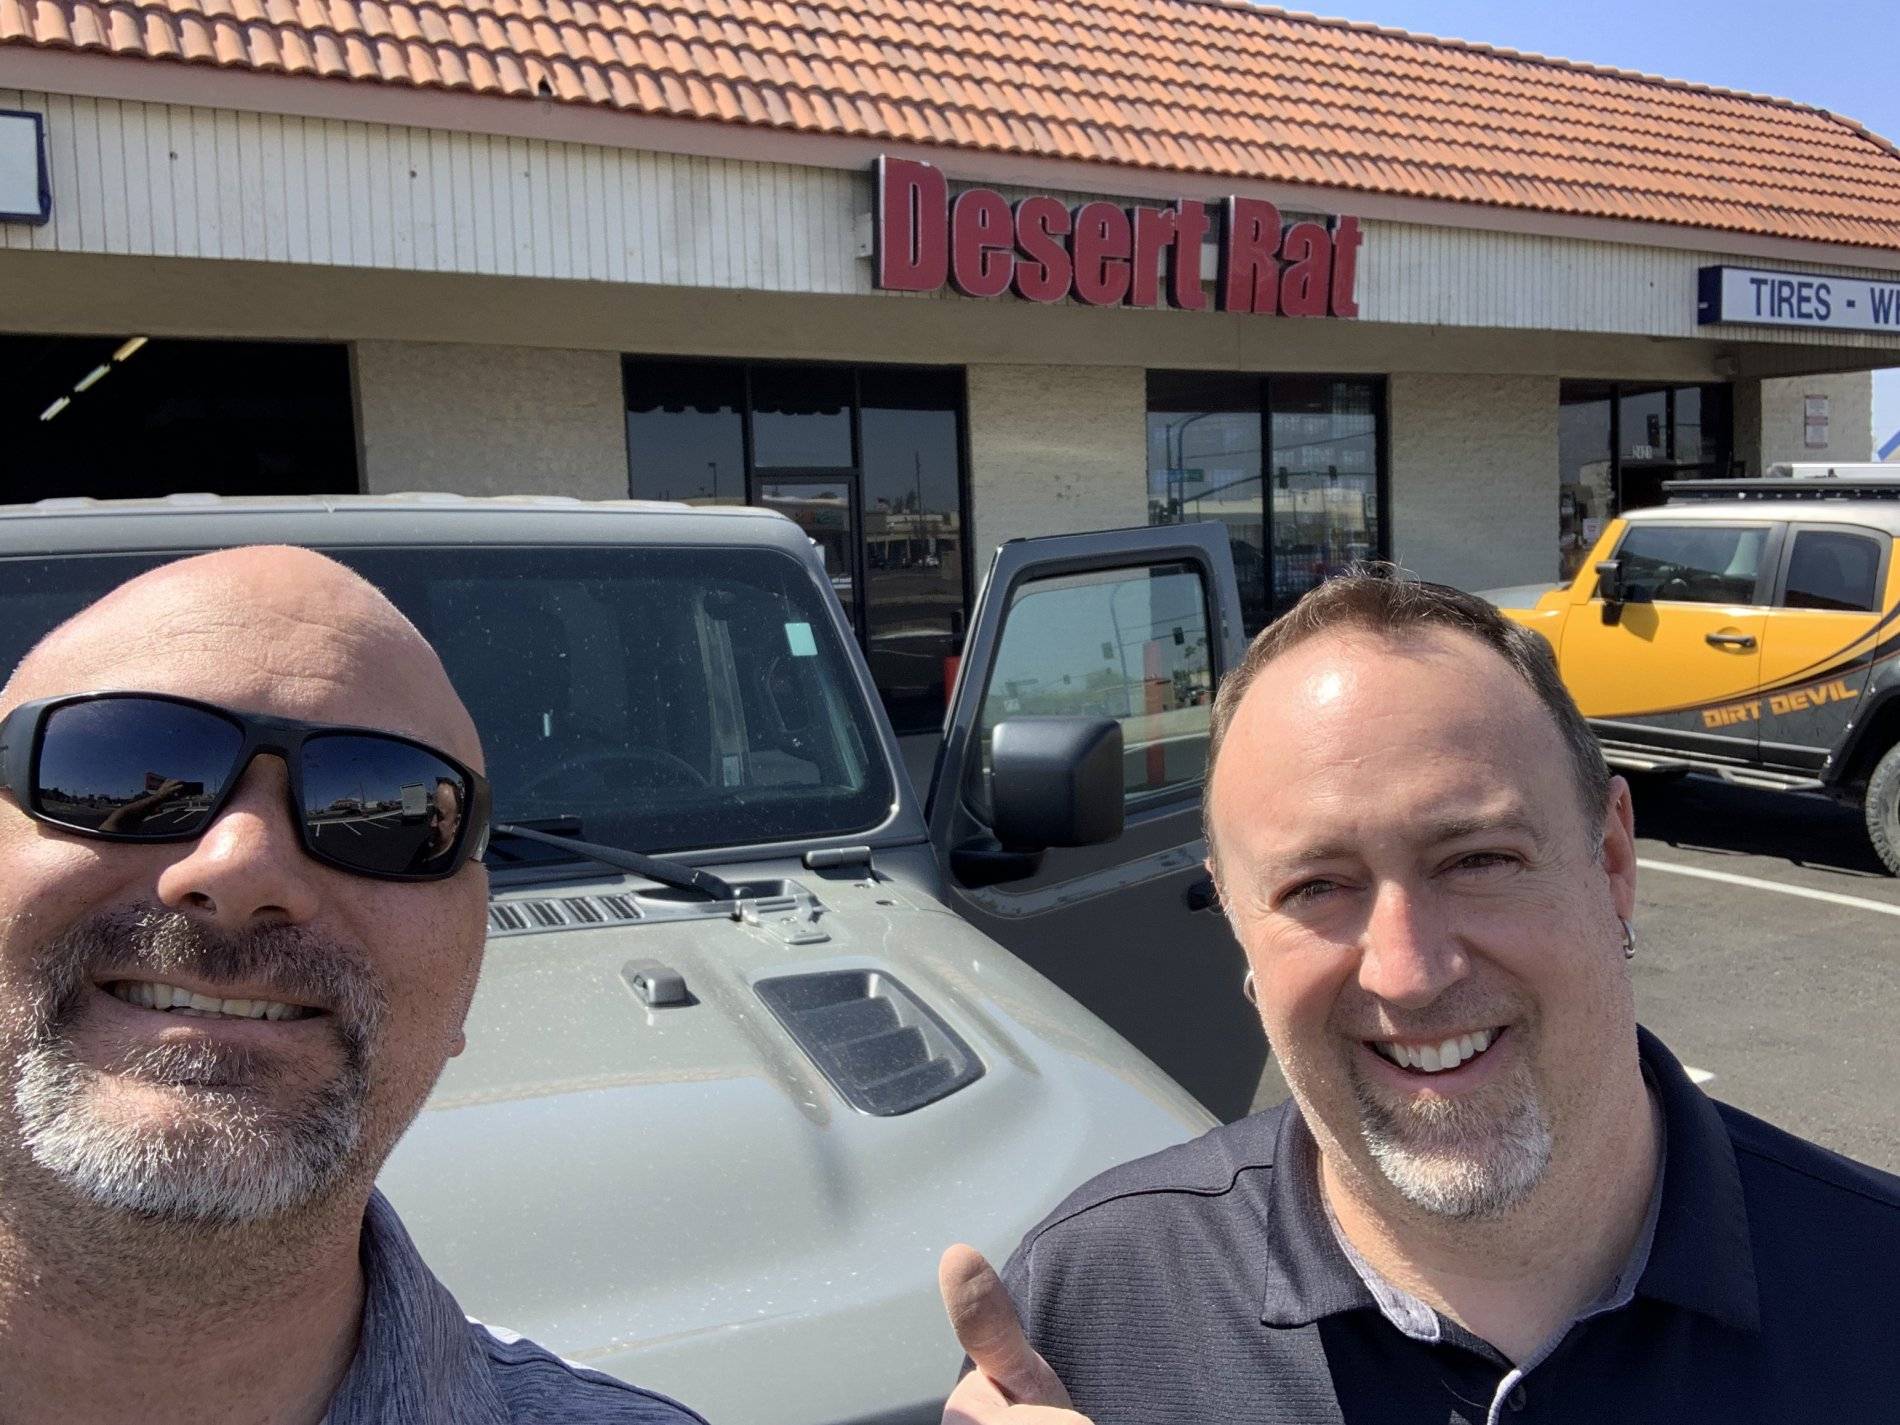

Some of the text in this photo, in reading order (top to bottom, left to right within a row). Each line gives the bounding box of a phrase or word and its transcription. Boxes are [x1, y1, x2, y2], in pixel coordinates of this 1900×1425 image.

[874, 154, 1363, 318] Desert Rat
[1750, 277, 1831, 321] TIRES
[1702, 681, 1858, 728] DIRT DEVIL
